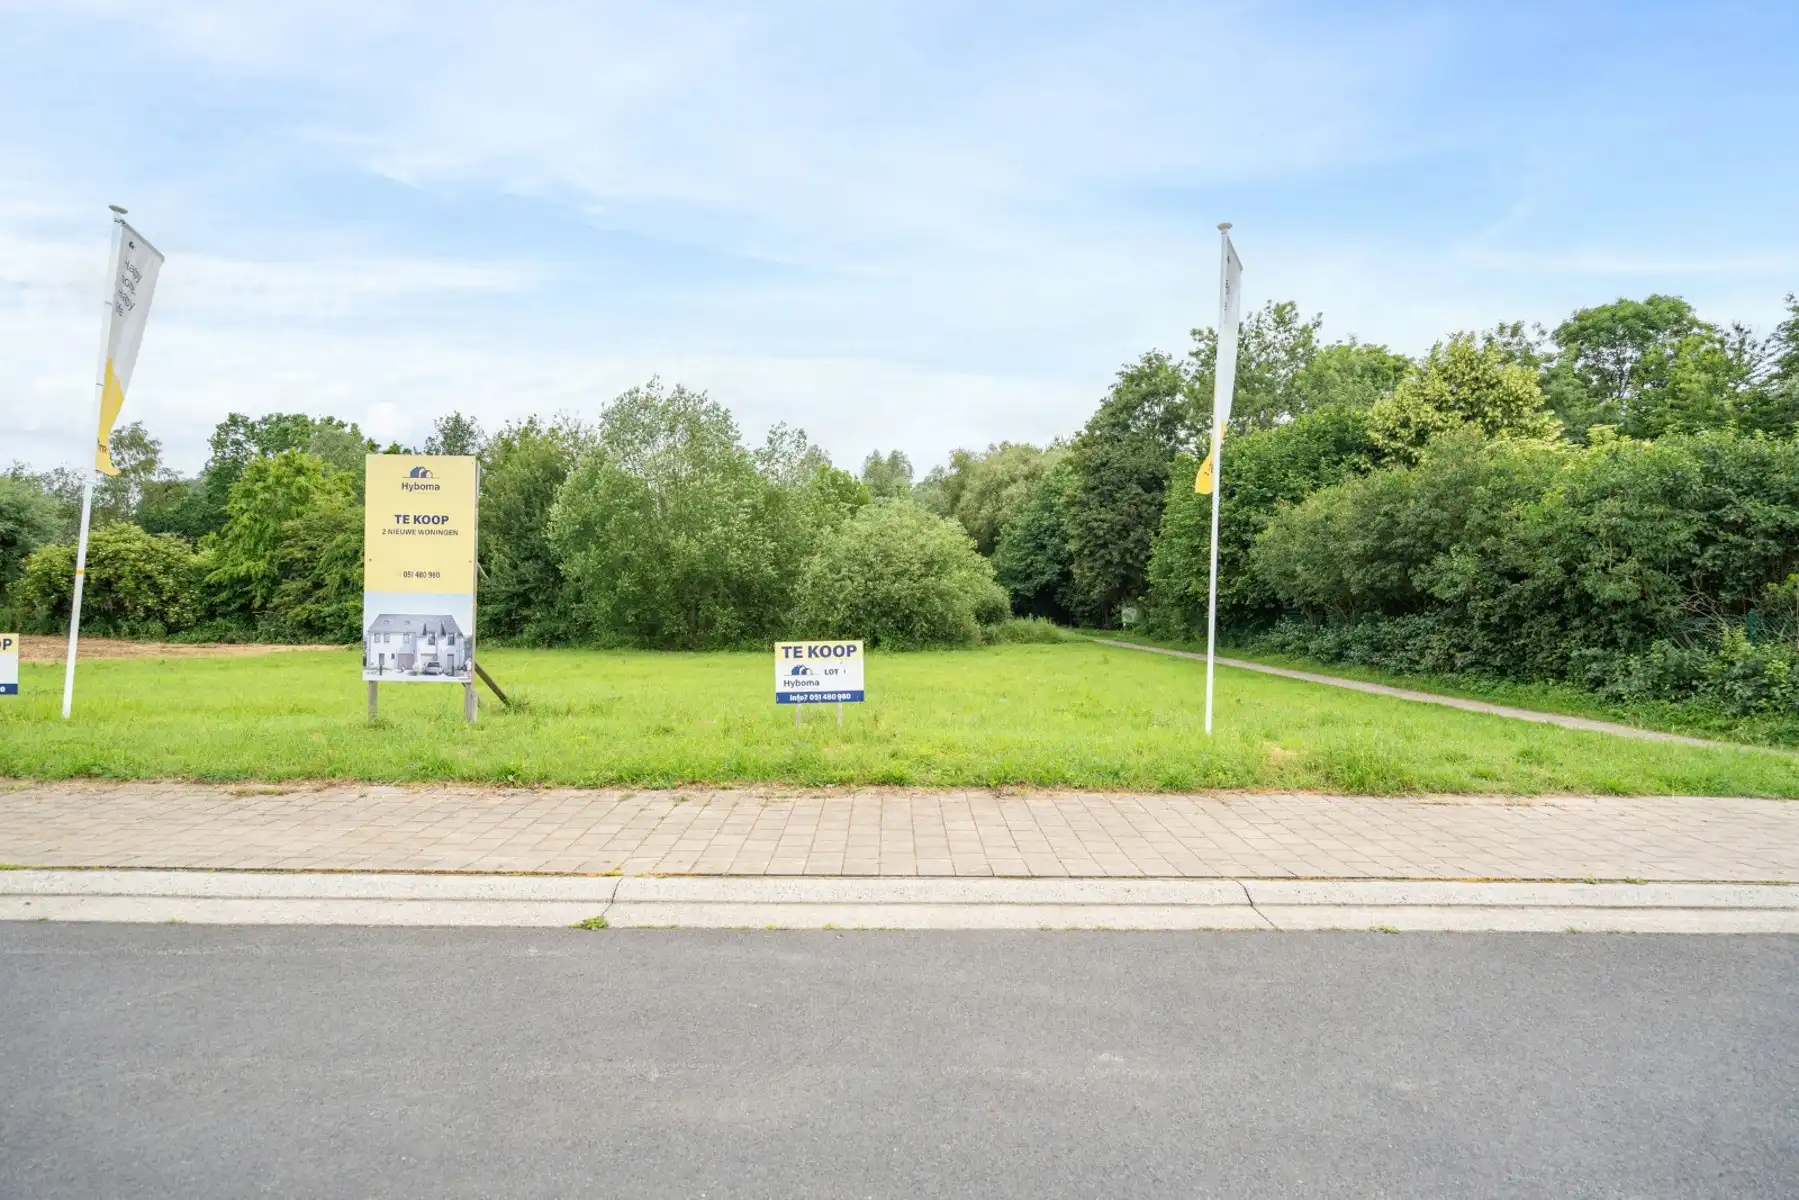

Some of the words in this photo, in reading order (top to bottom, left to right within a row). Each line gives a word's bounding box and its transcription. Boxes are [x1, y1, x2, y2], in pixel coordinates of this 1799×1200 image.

[401, 482, 440, 492] Hyboma
[394, 514, 410, 524] TE
[413, 515, 449, 525] KOOP
[781, 646, 803, 658] TE
[808, 645, 857, 658] KOOP
[784, 679, 820, 688] Hyboma
